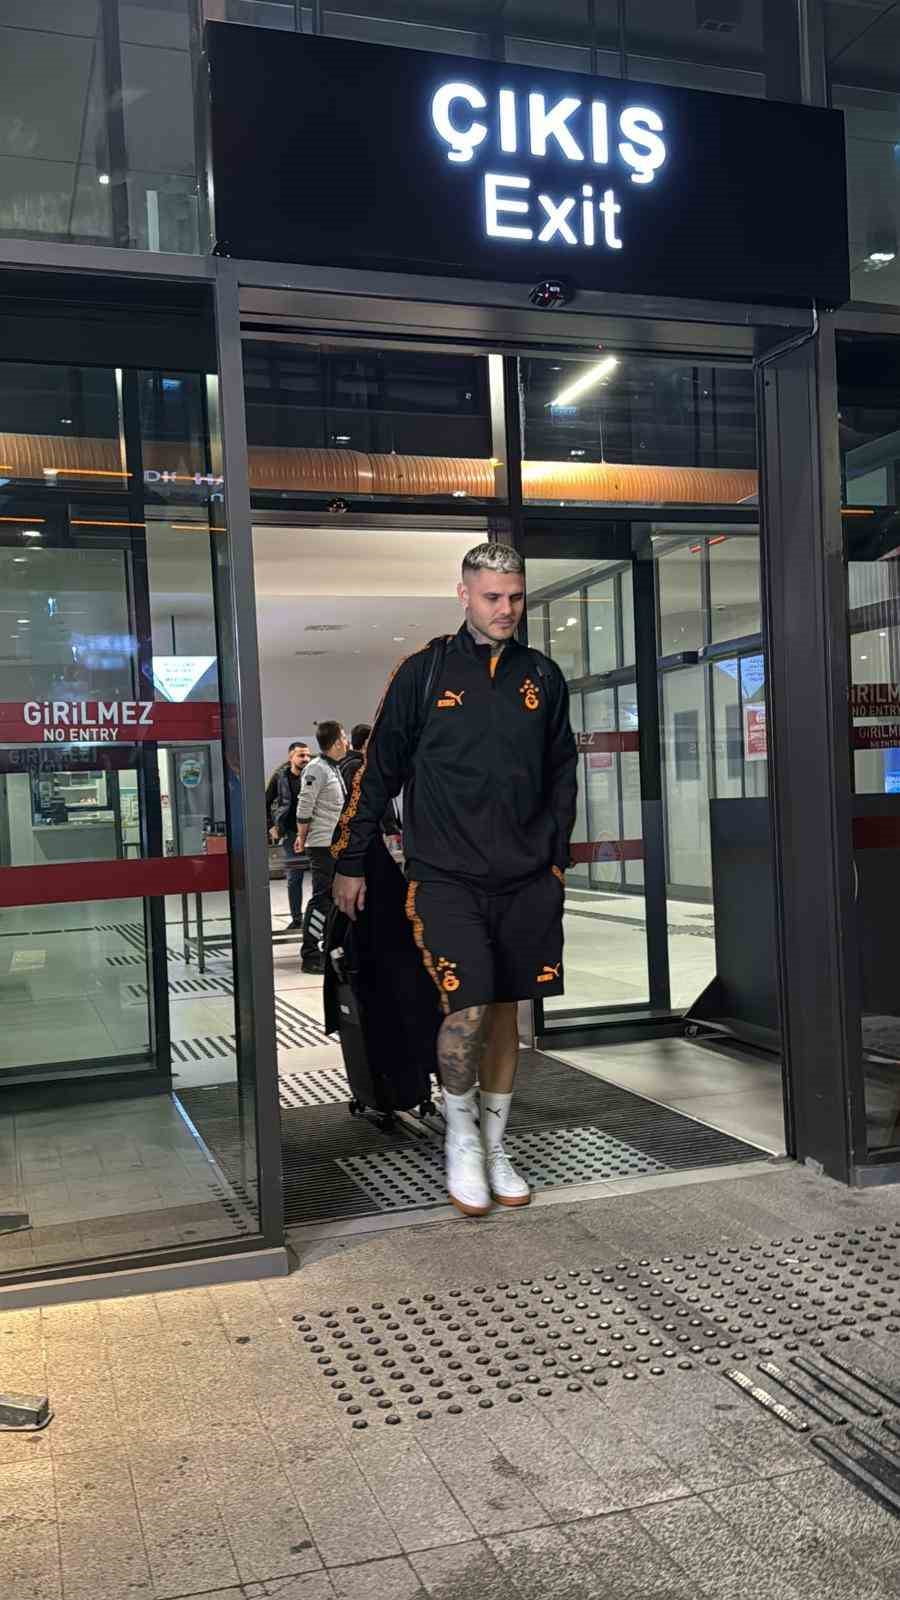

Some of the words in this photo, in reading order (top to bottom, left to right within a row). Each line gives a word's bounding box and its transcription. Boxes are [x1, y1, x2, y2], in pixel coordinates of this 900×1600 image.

[431, 82, 667, 184] ÇIKIŞ
[484, 173, 623, 249] Exit
[43, 728, 65, 742] NO
[69, 728, 119, 742] ENTRY
